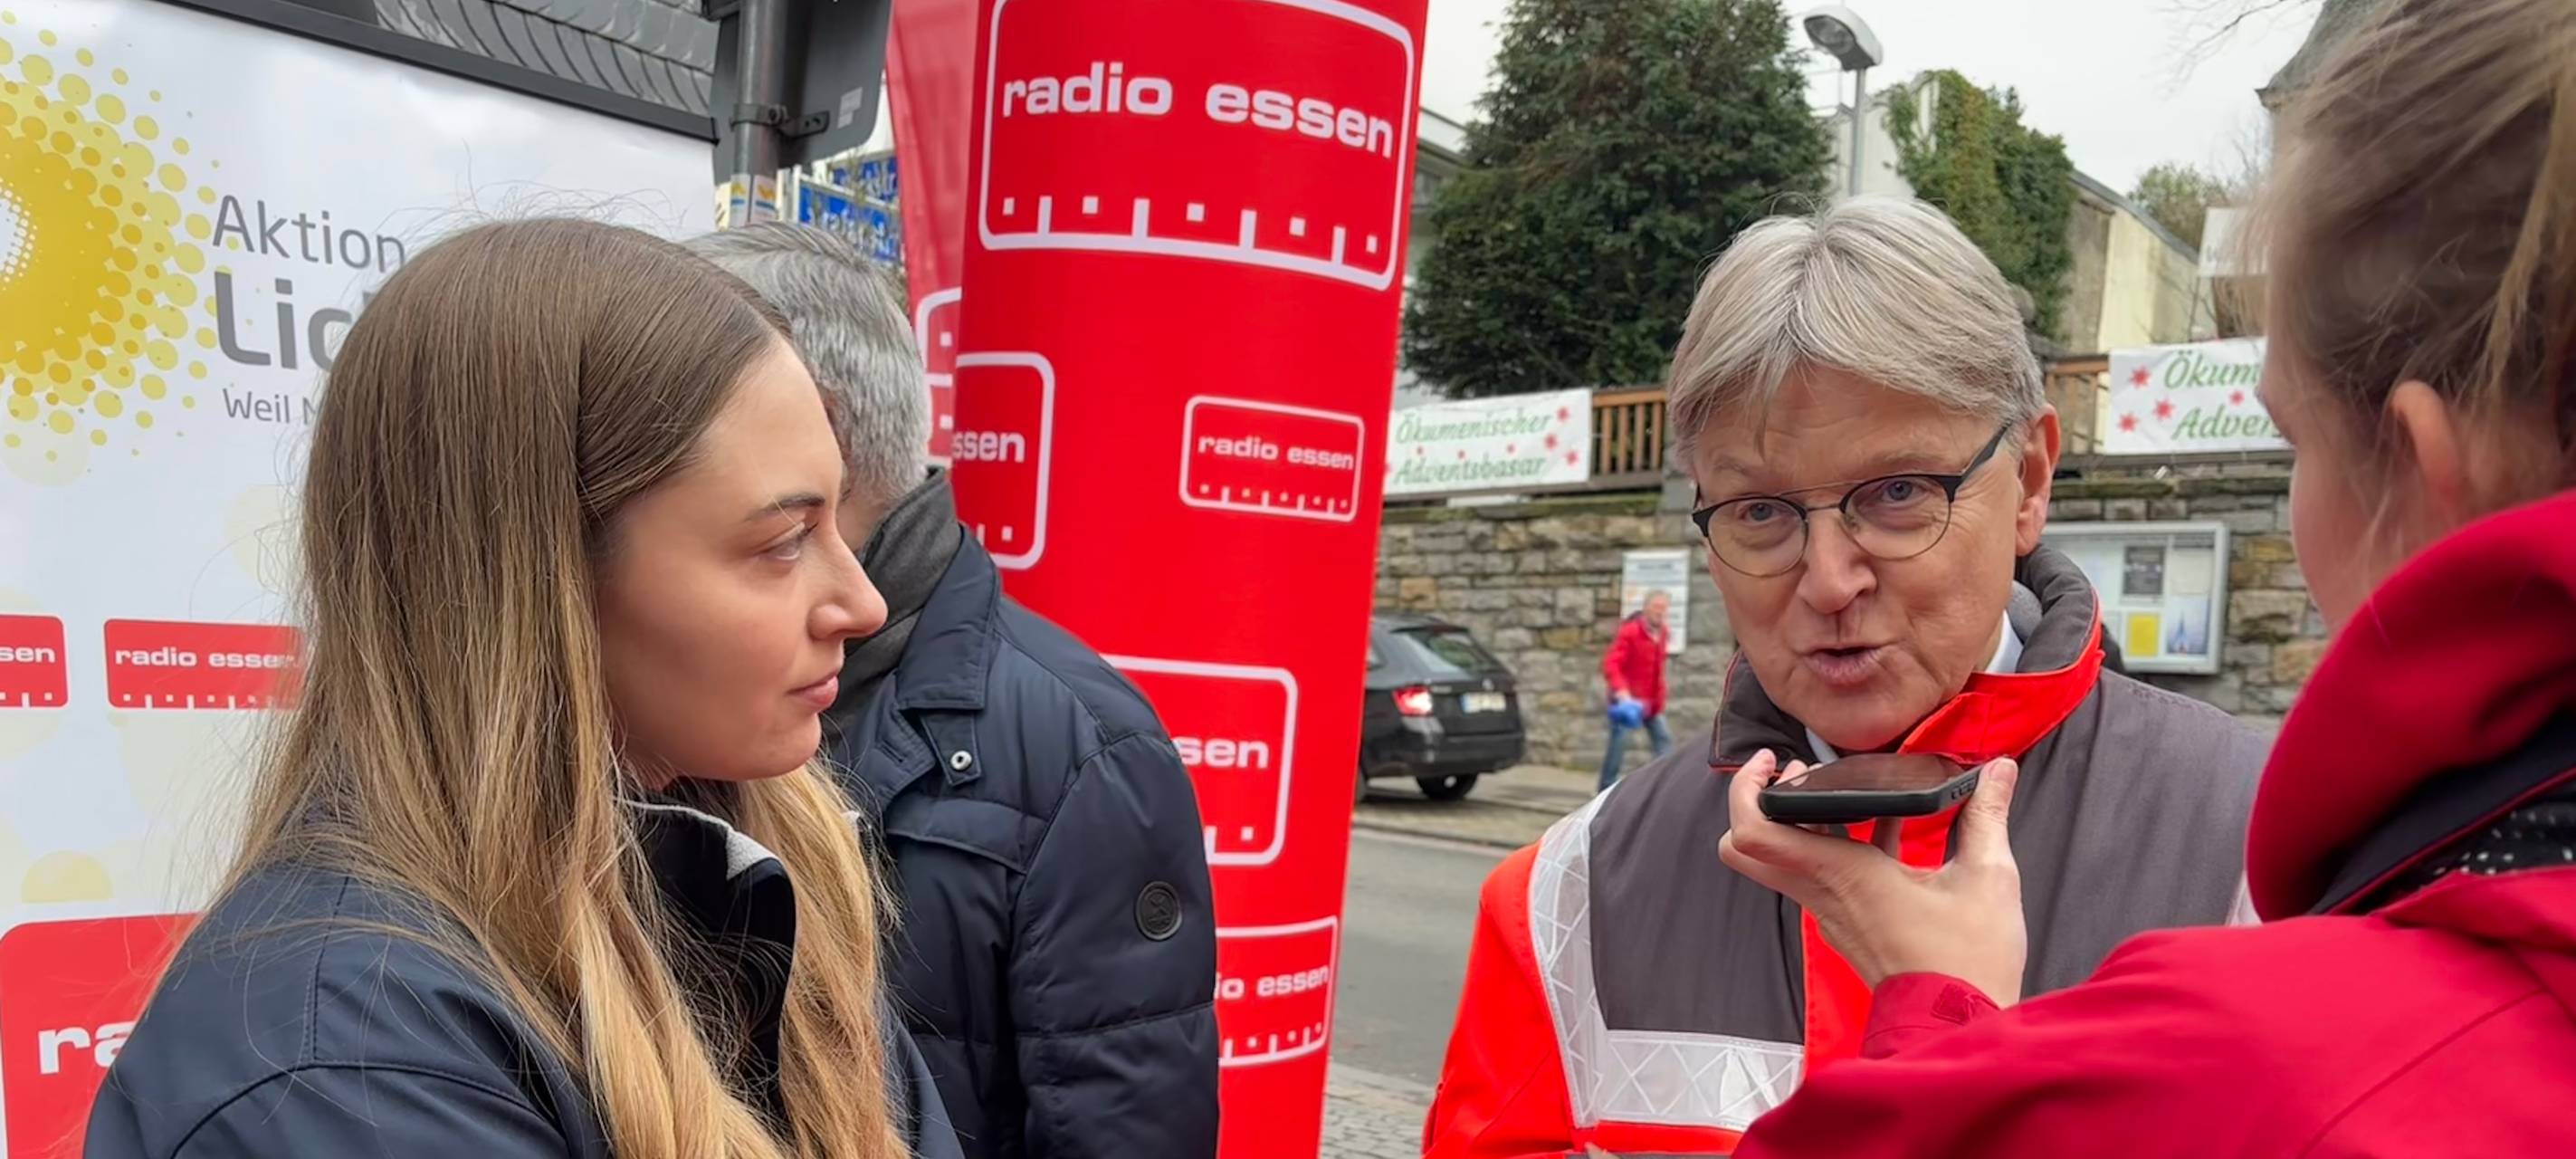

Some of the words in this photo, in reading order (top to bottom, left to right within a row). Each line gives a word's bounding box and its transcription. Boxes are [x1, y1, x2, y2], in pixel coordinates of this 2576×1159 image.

[1003, 62, 1173, 118] radio
[1205, 83, 1394, 158] essen
[213, 195, 406, 273] Aktion
[214, 271, 377, 374] Lic
[223, 388, 291, 424] Weil
[1395, 407, 1551, 444] Ökumenischer
[1197, 434, 1279, 461] radio
[1286, 445, 1355, 470] essen
[1394, 453, 1545, 484] Adventsbasar
[115, 647, 198, 667] radio
[1256, 965, 1330, 997] essen
